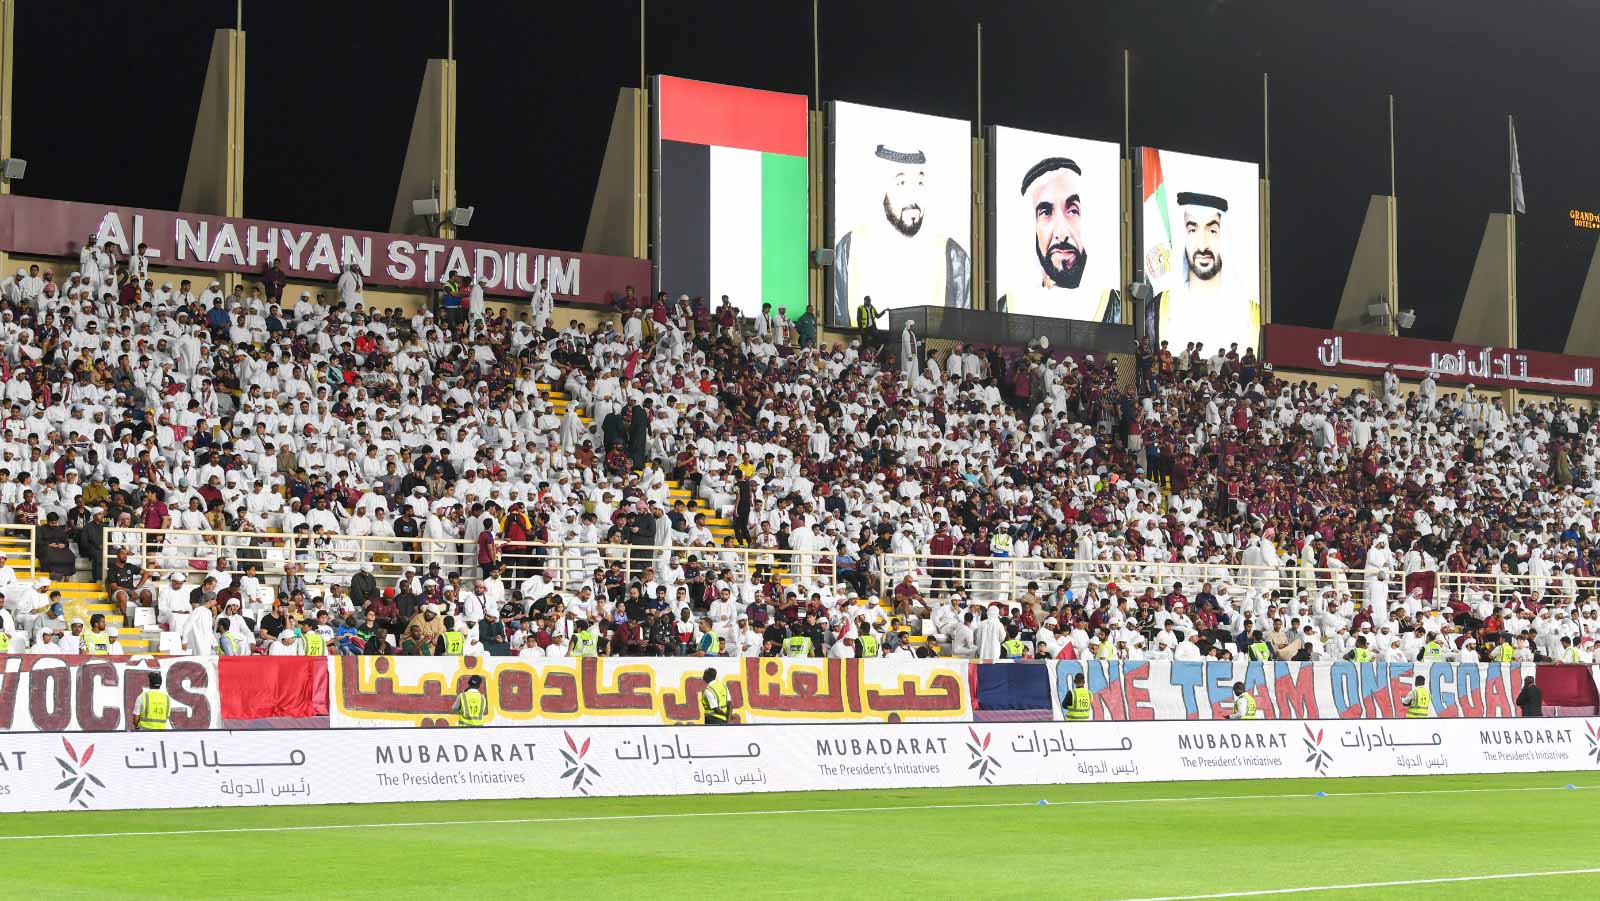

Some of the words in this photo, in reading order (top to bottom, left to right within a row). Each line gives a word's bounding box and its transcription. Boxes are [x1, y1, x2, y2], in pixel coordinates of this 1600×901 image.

[97, 211, 160, 258] AL
[175, 218, 372, 277] NAHYAN
[387, 240, 581, 296] STADIUM
[1056, 661, 1155, 720] ONE
[1170, 661, 1320, 720] TEAM
[1330, 662, 1416, 717] ONE
[1012, 730, 1132, 757] مبادرات
[1179, 734, 1286, 749] MUBADARAT
[1341, 726, 1441, 751] مبادرات
[1480, 730, 1571, 744] MUBADARAT
[377, 744, 535, 763] MUBADARAT
[615, 734, 760, 765] مبادرات
[817, 738, 946, 755] MUBADARAT
[125, 740, 305, 774] مبادرات
[1182, 757, 1196, 767] The
[1199, 756, 1241, 766] President's
[1243, 755, 1282, 766] Initiatives
[735, 768, 766, 784] رئيس
[819, 764, 837, 775] The
[840, 763, 891, 774] President's
[893, 763, 940, 774] Initiatives
[1078, 762, 1107, 776] الدولة
[1112, 760, 1138, 775] رئيس
[376, 773, 398, 785] The
[403, 772, 465, 784] President's
[469, 772, 525, 783] Initiatives
[694, 769, 729, 785] الدولة
[221, 779, 264, 797] الدولة
[272, 778, 310, 796] رئيس
